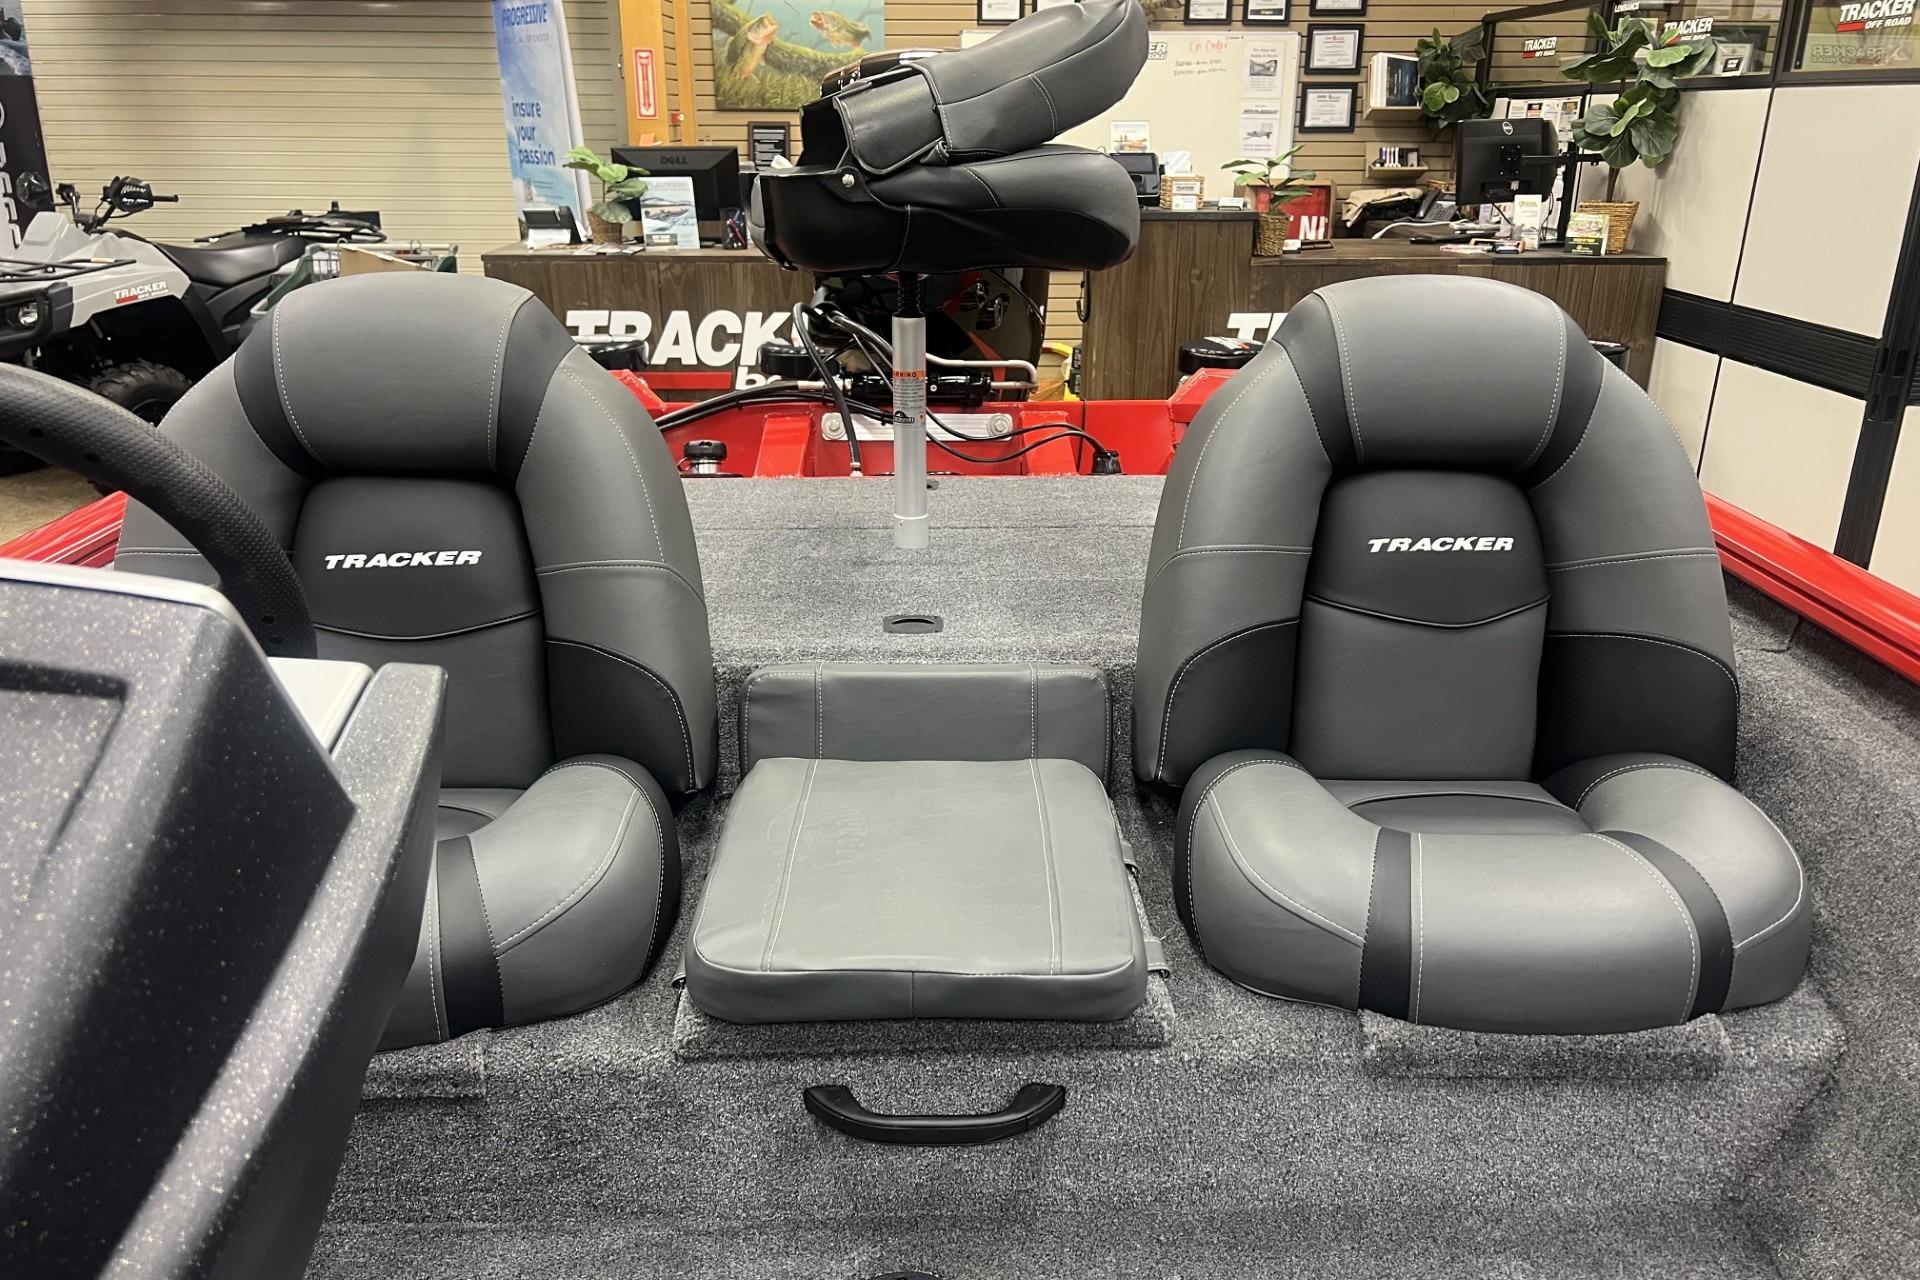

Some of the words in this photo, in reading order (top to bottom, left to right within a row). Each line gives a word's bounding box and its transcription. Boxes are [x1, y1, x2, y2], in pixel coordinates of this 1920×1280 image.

[502, 3, 548, 27] PROGRESSIVE
[1840, 0, 1914, 22] TRACKER
[1663, 17, 1714, 35] TRACKER
[1864, 20, 1883, 30] OFF
[1884, 16, 1912, 28] ROAD
[1524, 36, 1557, 52] TRACKER
[511, 96, 541, 117] insure
[515, 126, 536, 146] your
[518, 144, 556, 168] passion
[660, 155, 689, 165] DELL
[113, 281, 167, 300] TRACKER
[1368, 536, 1515, 553] TRACKER
[324, 550, 483, 570] TRACKER
